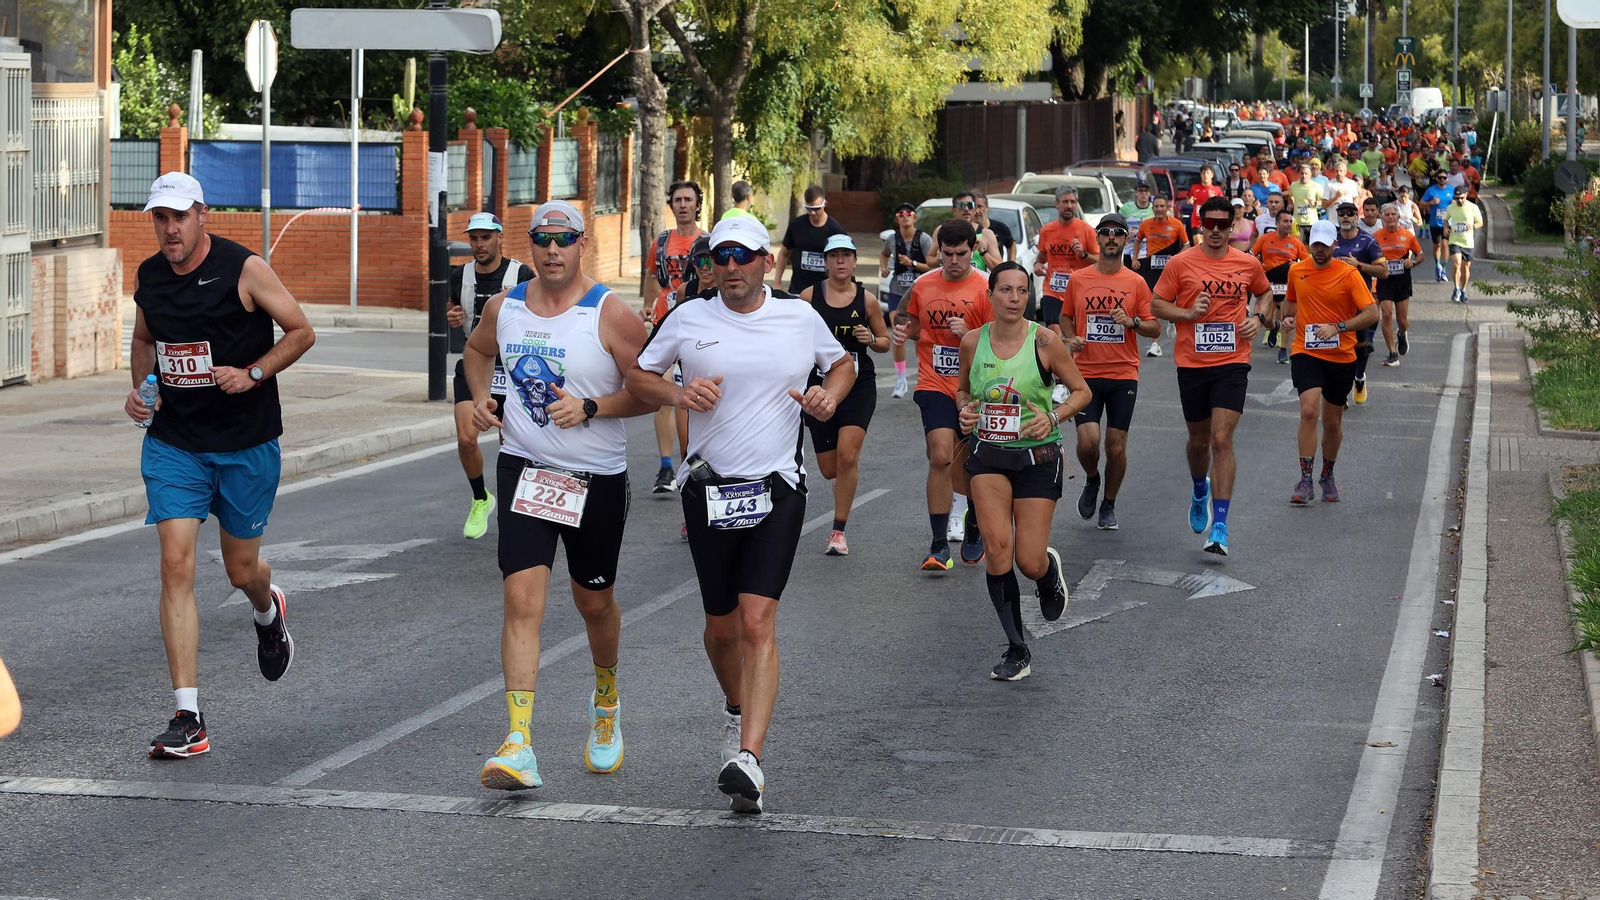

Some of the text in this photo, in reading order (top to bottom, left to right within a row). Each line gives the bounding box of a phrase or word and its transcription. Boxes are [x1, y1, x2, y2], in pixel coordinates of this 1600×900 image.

[1202, 280, 1243, 296] XXIX
[1085, 295, 1125, 311] XXIX
[1096, 324, 1116, 334] 906
[1202, 332, 1230, 343] 1052
[505, 343, 566, 359] RUNNERS
[168, 357, 197, 373] 310
[984, 416, 1007, 430] 159
[532, 485, 567, 508] 226
[725, 498, 757, 516] 643
